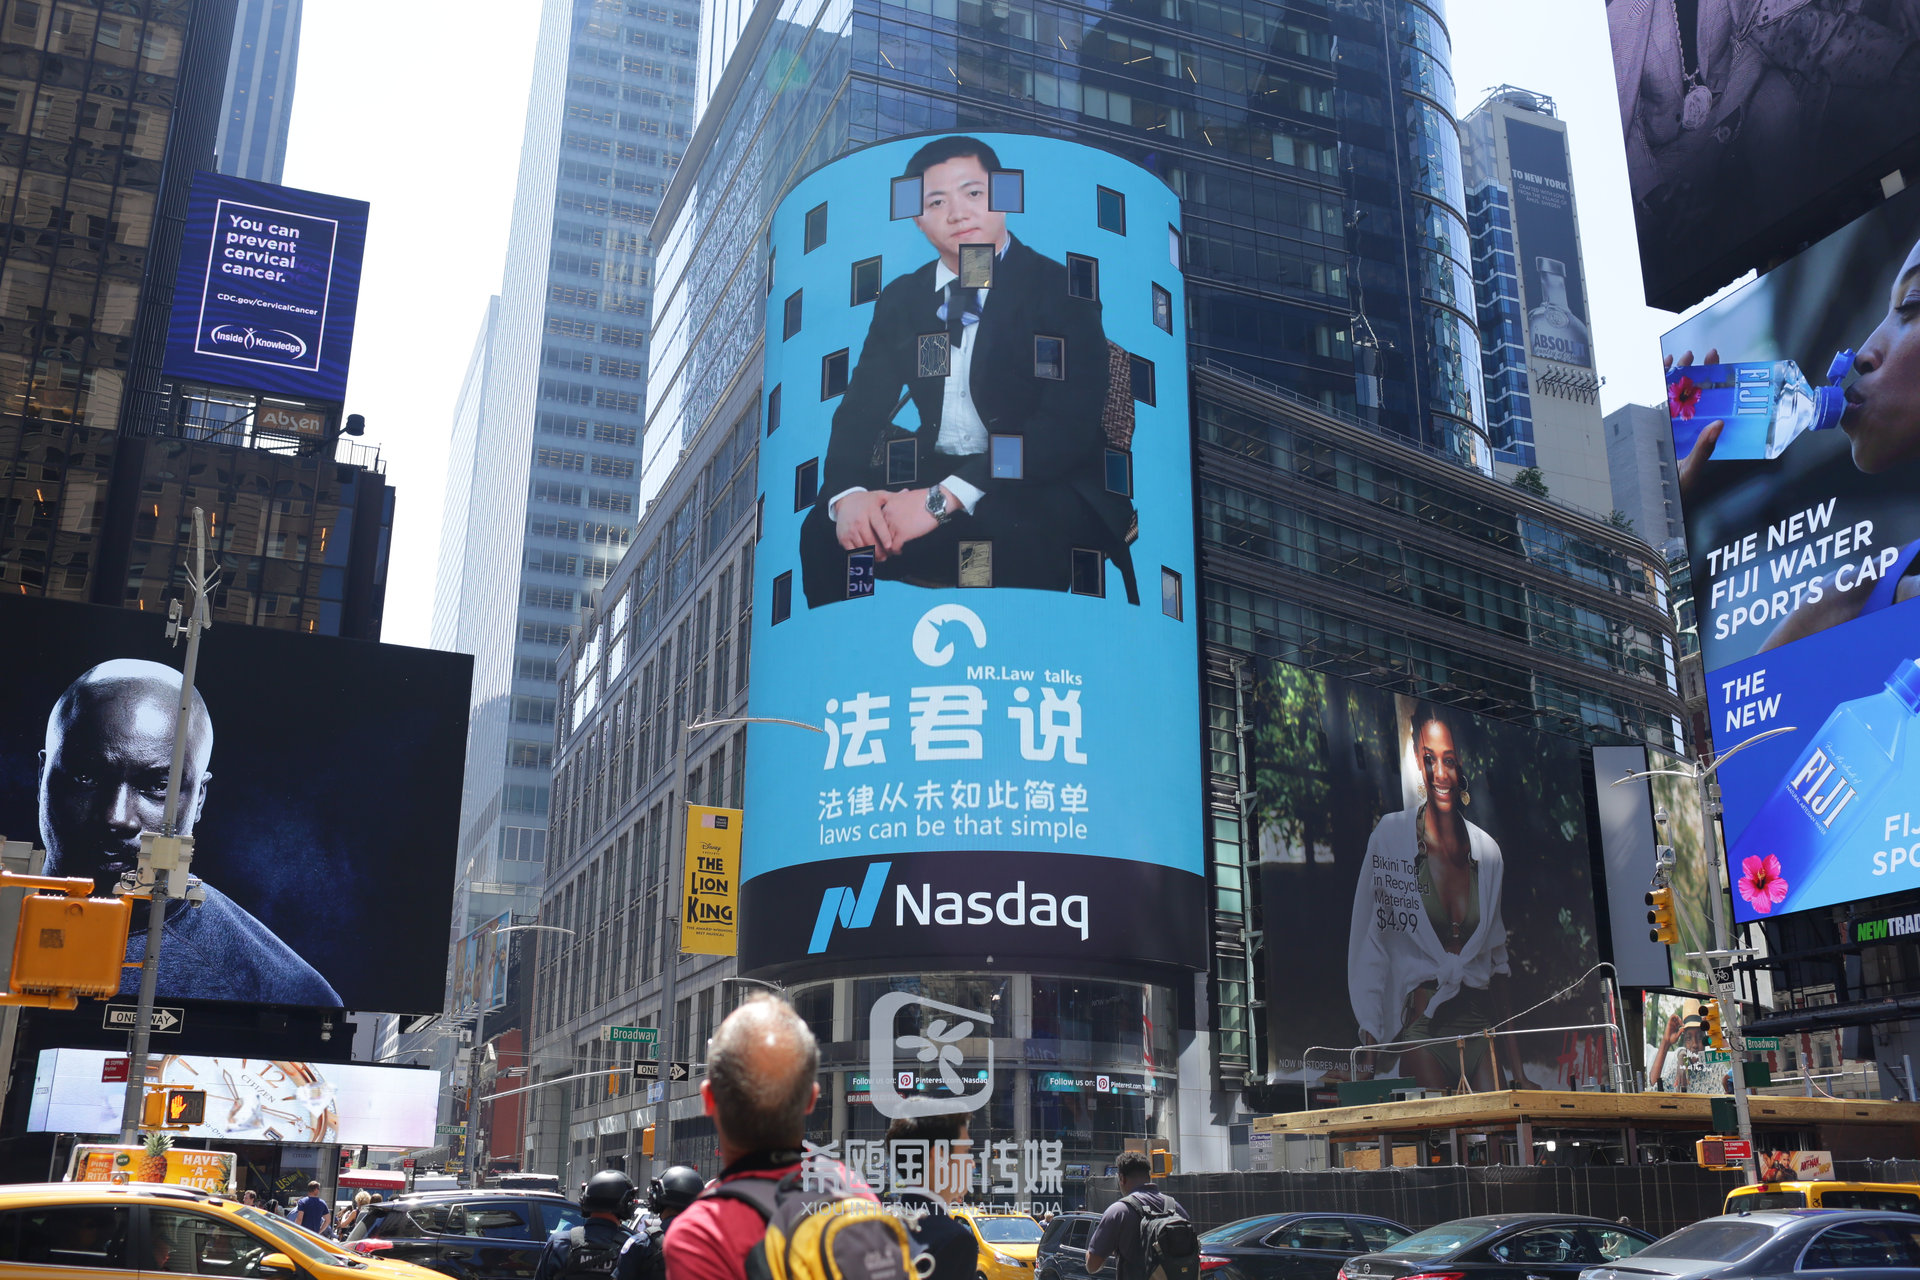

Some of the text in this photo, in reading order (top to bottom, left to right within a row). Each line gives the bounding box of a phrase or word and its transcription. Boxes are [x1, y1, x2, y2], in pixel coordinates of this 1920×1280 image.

[1512, 169, 1523, 179] TO
[1524, 172, 1542, 184] NEW
[230, 214, 300, 239] You can
[226, 231, 297, 253] prevent
[224, 247, 296, 269] cervical
[222, 262, 286, 283] cancer.
[217, 293, 318, 316] CDC.gov/CervicalCancer
[217, 331, 301, 353] Inside Knowledge
[1738, 368, 1770, 416] FIJI
[262, 412, 320, 431] Absen
[1706, 497, 1837, 577] THE NEW
[1711, 520, 1874, 610] FIJI WATER
[1714, 546, 1900, 640] SPORTS CAP
[966, 666, 1082, 686] MR.Law talks
[1722, 669, 1766, 704] THE
[1725, 693, 1782, 733] NEW
[823, 685, 1088, 771] 法君说
[1790, 746, 1857, 829] FIJI
[818, 779, 1089, 821] 法律从未如此简单
[1786, 784, 1827, 836] NATURAL ARTESIAN WATER
[820, 814, 1088, 845] laws can be that simple
[697, 856, 724, 871] THE
[1372, 855, 1420, 878] Bikini Top
[692, 872, 728, 895] LION
[1374, 873, 1430, 894] in Recycled
[687, 896, 733, 923] KING
[896, 880, 1089, 941] Nasdaq
[1374, 890, 1420, 910] Materials
[1376, 907, 1418, 933] $4.99
[1722, 982, 1734, 990] LANE
[116, 1012, 172, 1024] ONE WAY
[613, 1028, 656, 1042] Broadway
[1748, 1040, 1777, 1050] Broadway
[642, 1066, 657, 1074] ONE
[1280, 1059, 1296, 1068] NOW
[1298, 1060, 1304, 1068] IN
[1306, 1060, 1332, 1070] STORES
[1334, 1062, 1348, 1072] AND
[1557, 1032, 1604, 1087] H&M
[257, 1064, 286, 1088] 12
[1050, 1078, 1074, 1086] Follow
[242, 1074, 276, 1103] CITIZEN
[438, 1126, 465, 1134] BROADWAY
[90, 1160, 110, 1168] PINE
[183, 1154, 219, 1166] HAVE
[88, 1172, 108, 1180] RITA
[179, 1177, 216, 1190] RITA
